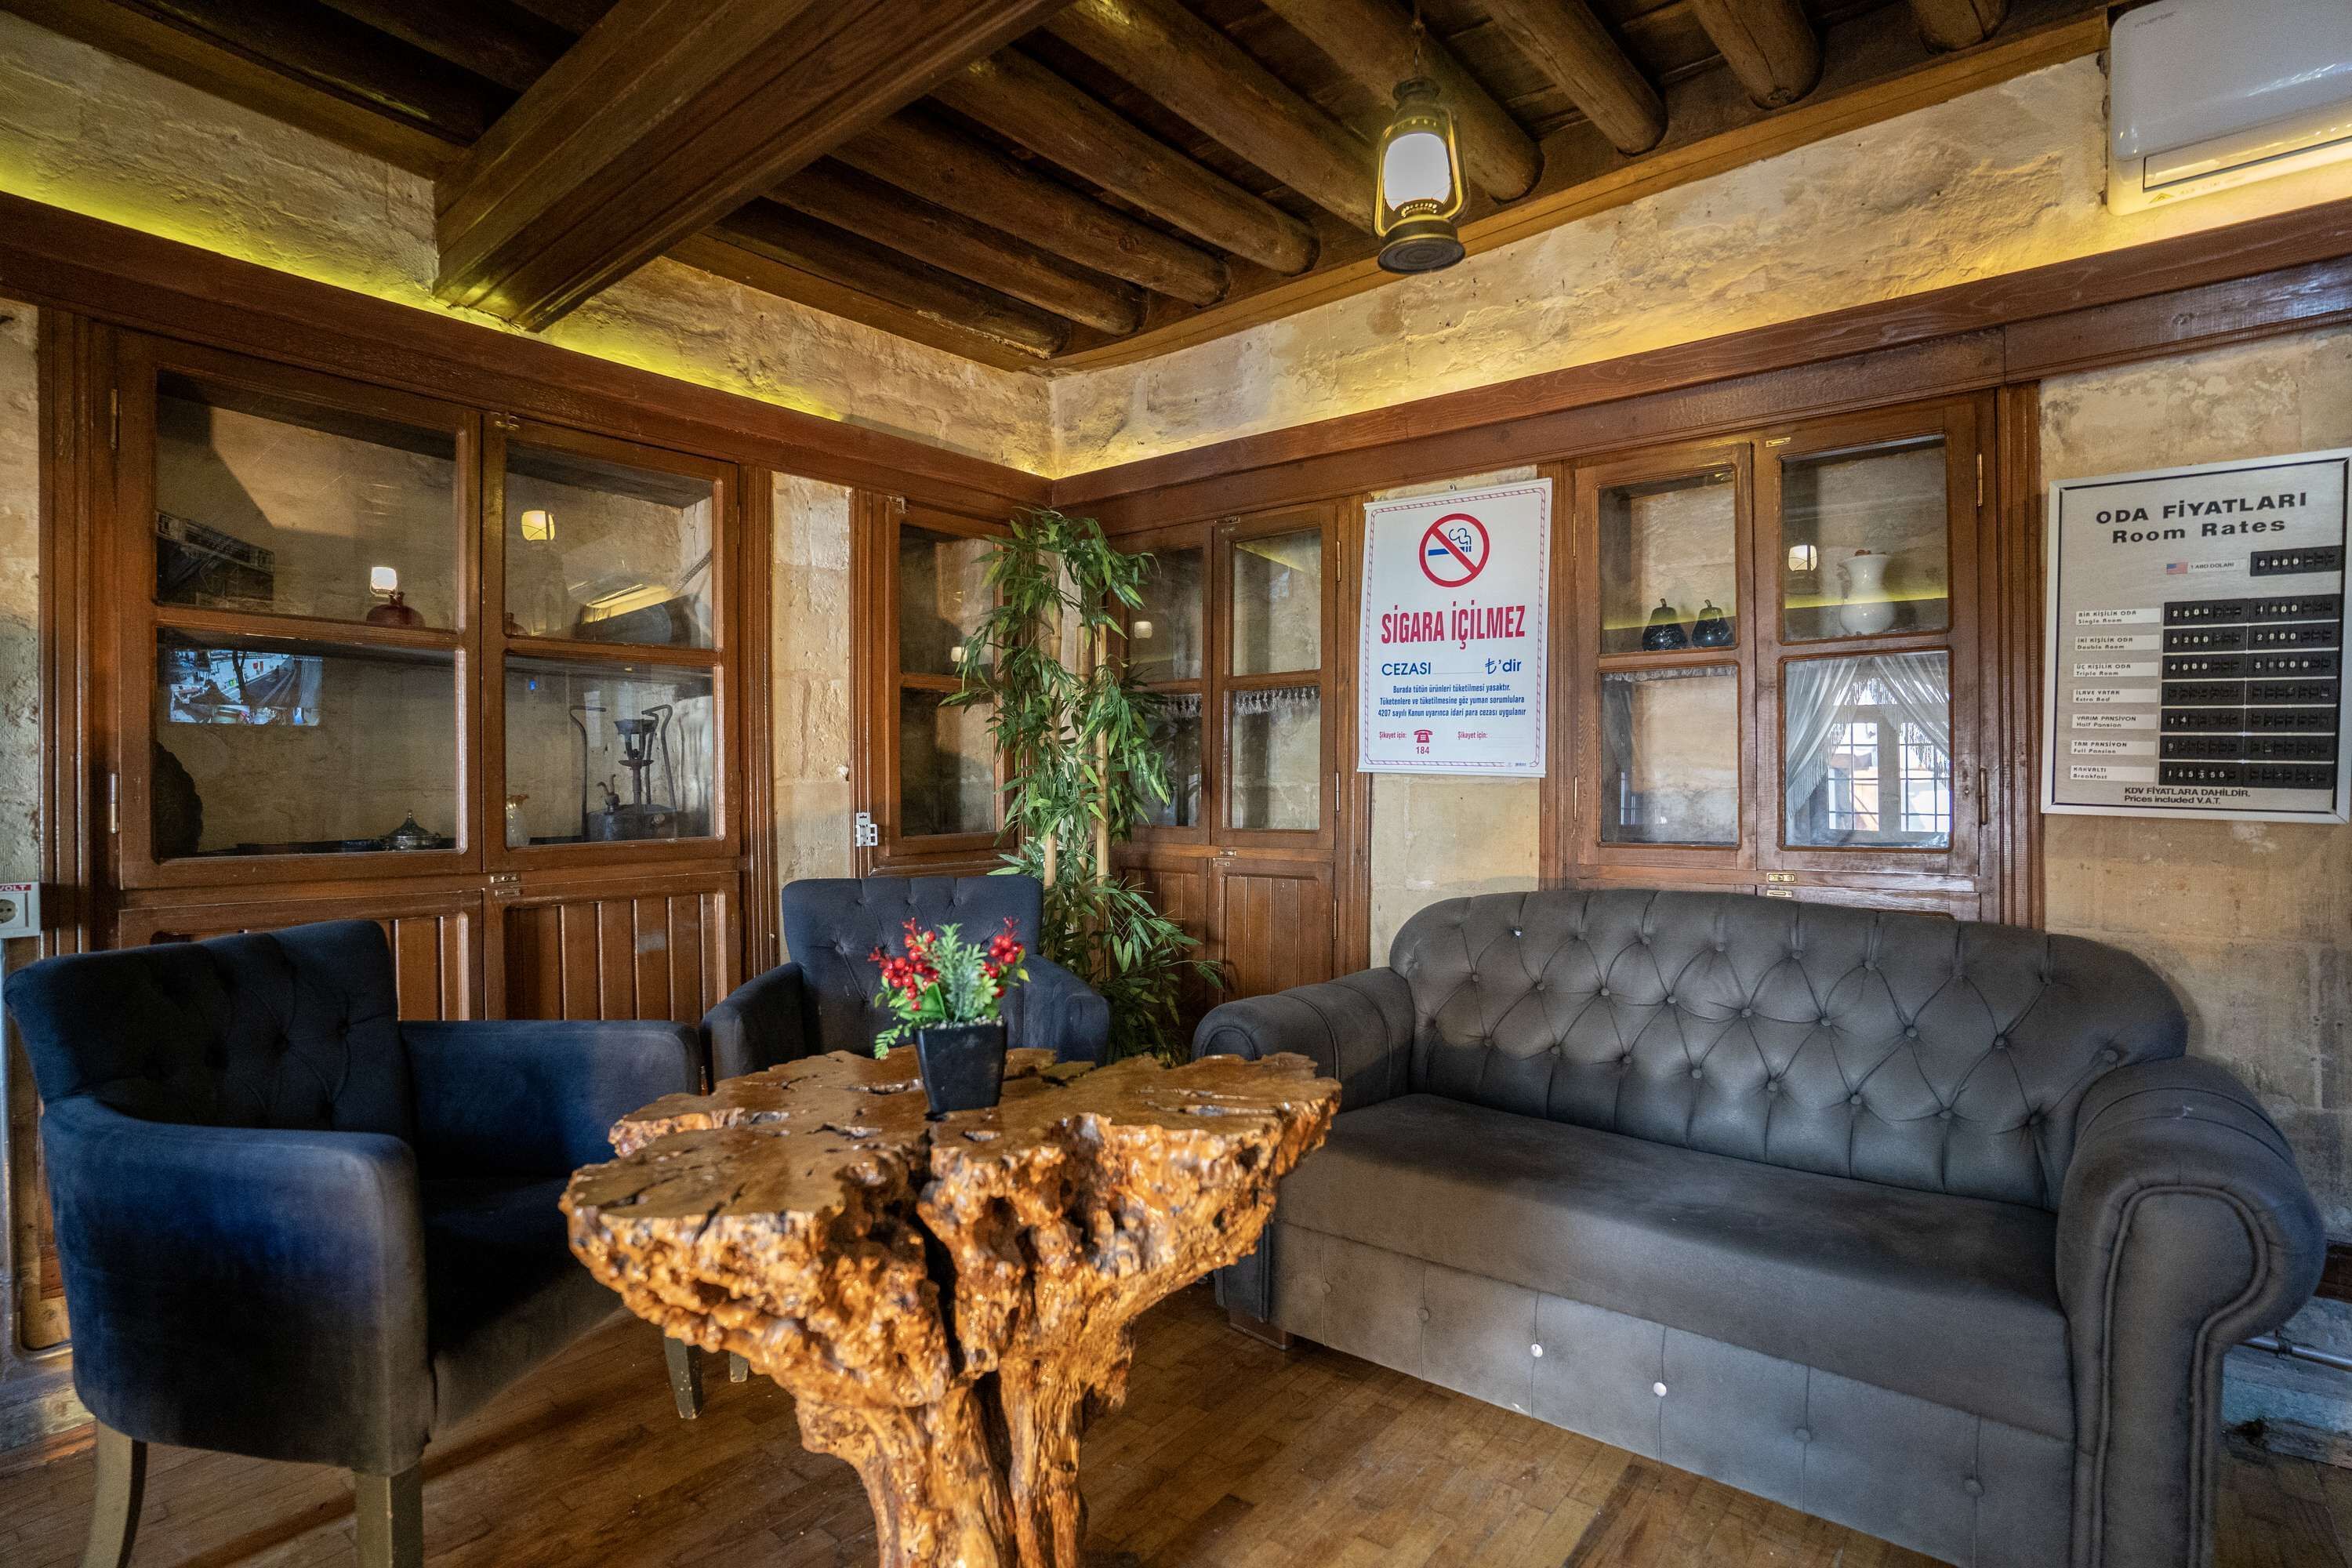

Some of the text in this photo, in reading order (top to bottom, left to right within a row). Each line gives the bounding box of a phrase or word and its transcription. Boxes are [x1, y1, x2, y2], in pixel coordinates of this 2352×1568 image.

[2096, 492, 2307, 524] ODA FİYATLARI
[2112, 520, 2285, 543] Room Rates
[1381, 600, 1526, 650] SİGARA İÇİLMEZ
[1381, 662, 1431, 676] CEZASI
[1392, 685, 1412, 694] Burada
[1452, 684, 1485, 692] tüketilmesi
[1486, 683, 1511, 693] yasaktır.
[1379, 697, 1410, 706] Tüketenlere
[1420, 696, 1457, 705] tüketilmesine
[1458, 696, 1468, 706] göz
[1392, 710, 1406, 718] sayılı
[1499, 709, 1526, 717] uygulanır
[1379, 731, 1406, 740] Şikayet için:
[1457, 731, 1475, 740] Şikayet
[2147, 787, 2198, 796] FİYATLARA
[2201, 788, 2250, 797] DAHİLDİR.
